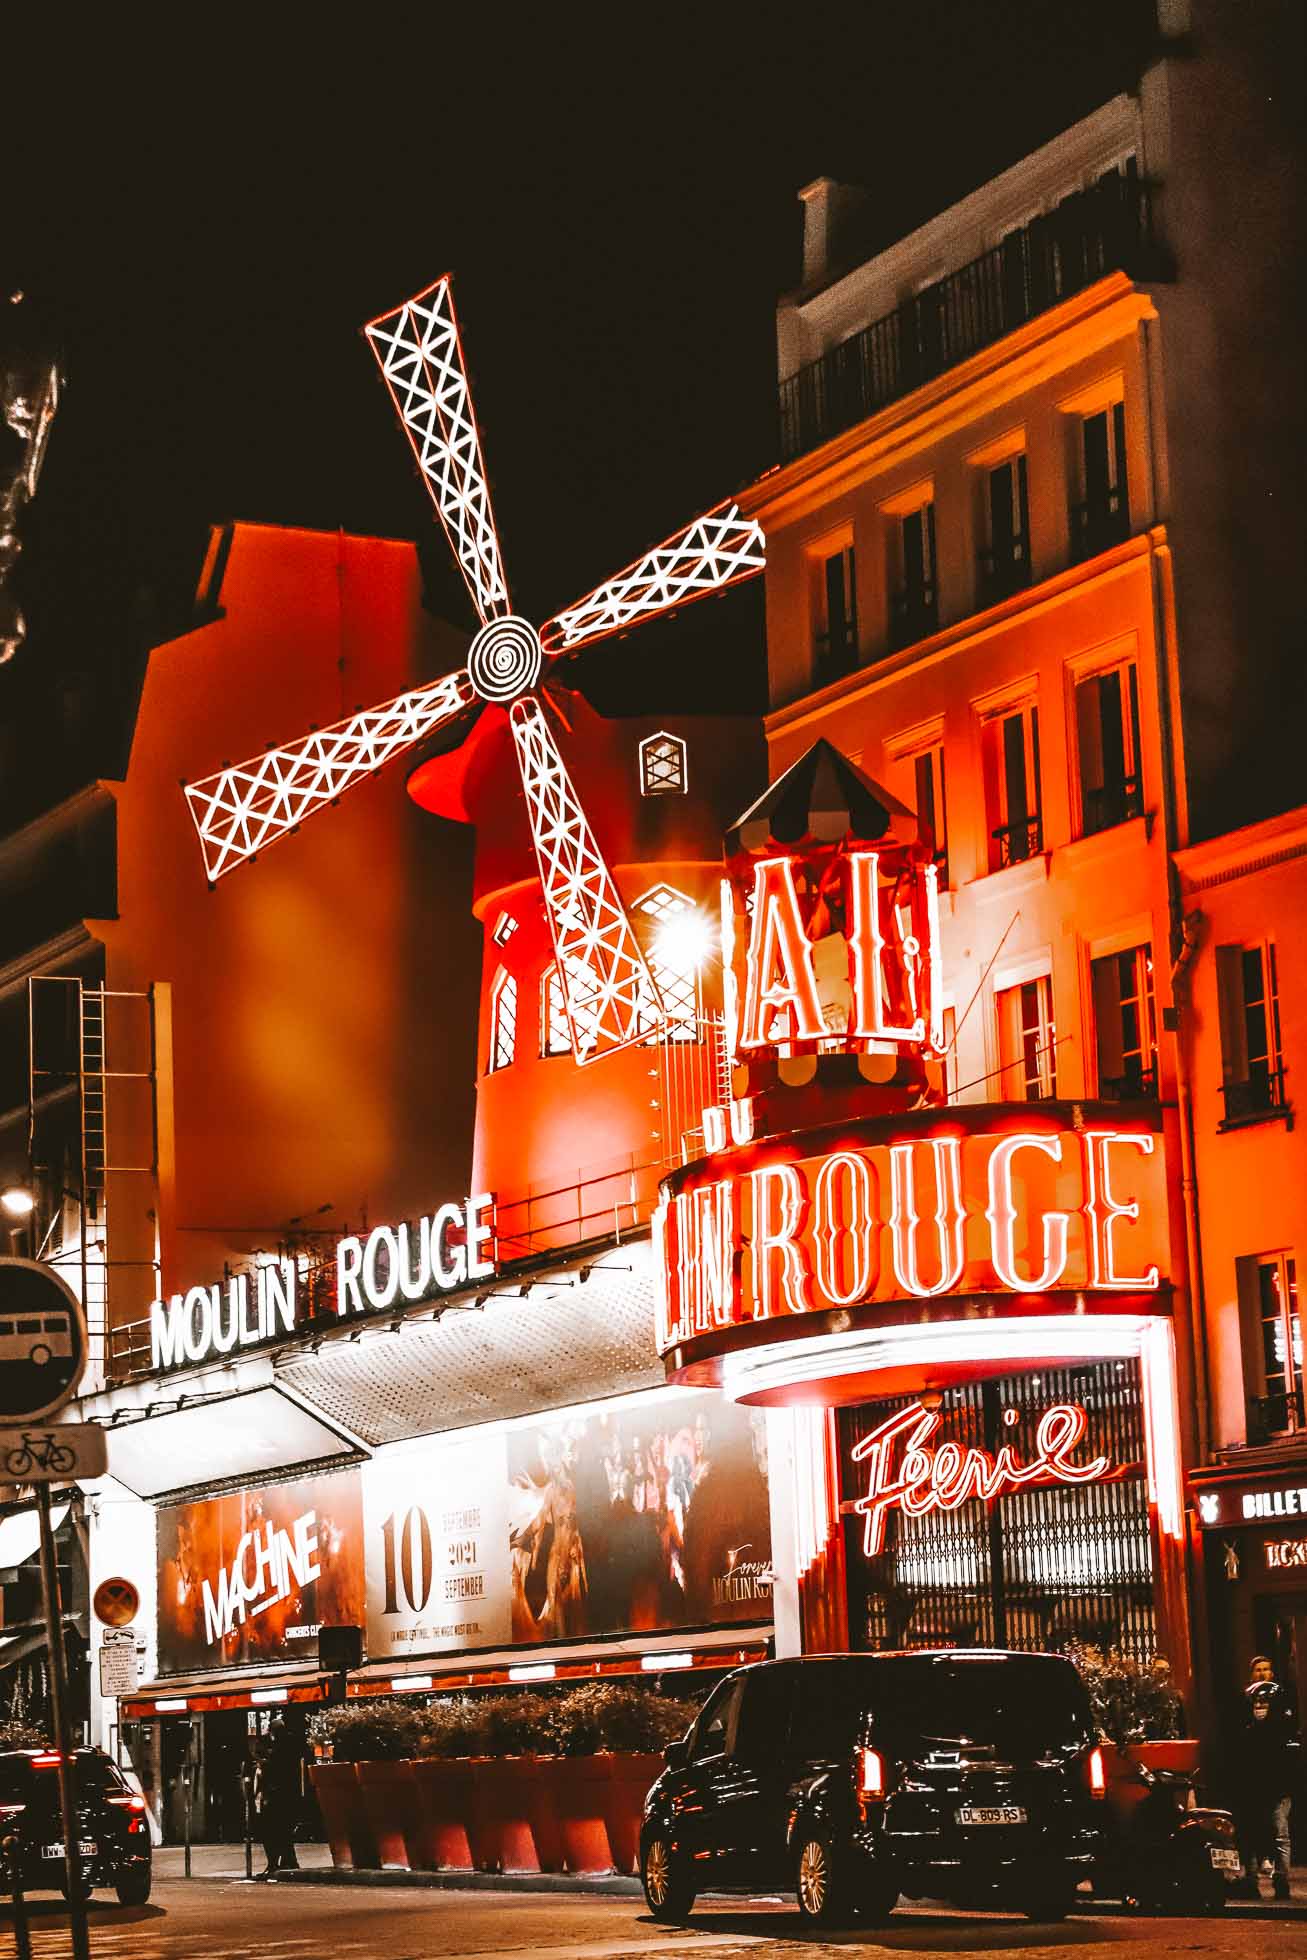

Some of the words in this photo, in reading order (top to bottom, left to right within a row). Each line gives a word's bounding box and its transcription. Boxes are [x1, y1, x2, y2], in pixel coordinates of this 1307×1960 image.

[702, 1097, 754, 1153] DU
[751, 1132, 1159, 1321] ROUGE
[151, 1259, 296, 1369] MOULIN
[336, 1192, 495, 1316] ROUGE
[201, 1510, 322, 1645] MACHINE
[381, 1504, 433, 1615] 10
[445, 1576, 484, 1599] SEPTEMBER
[448, 1541, 477, 1566] 2021
[713, 1577, 752, 1602] MOULIN
